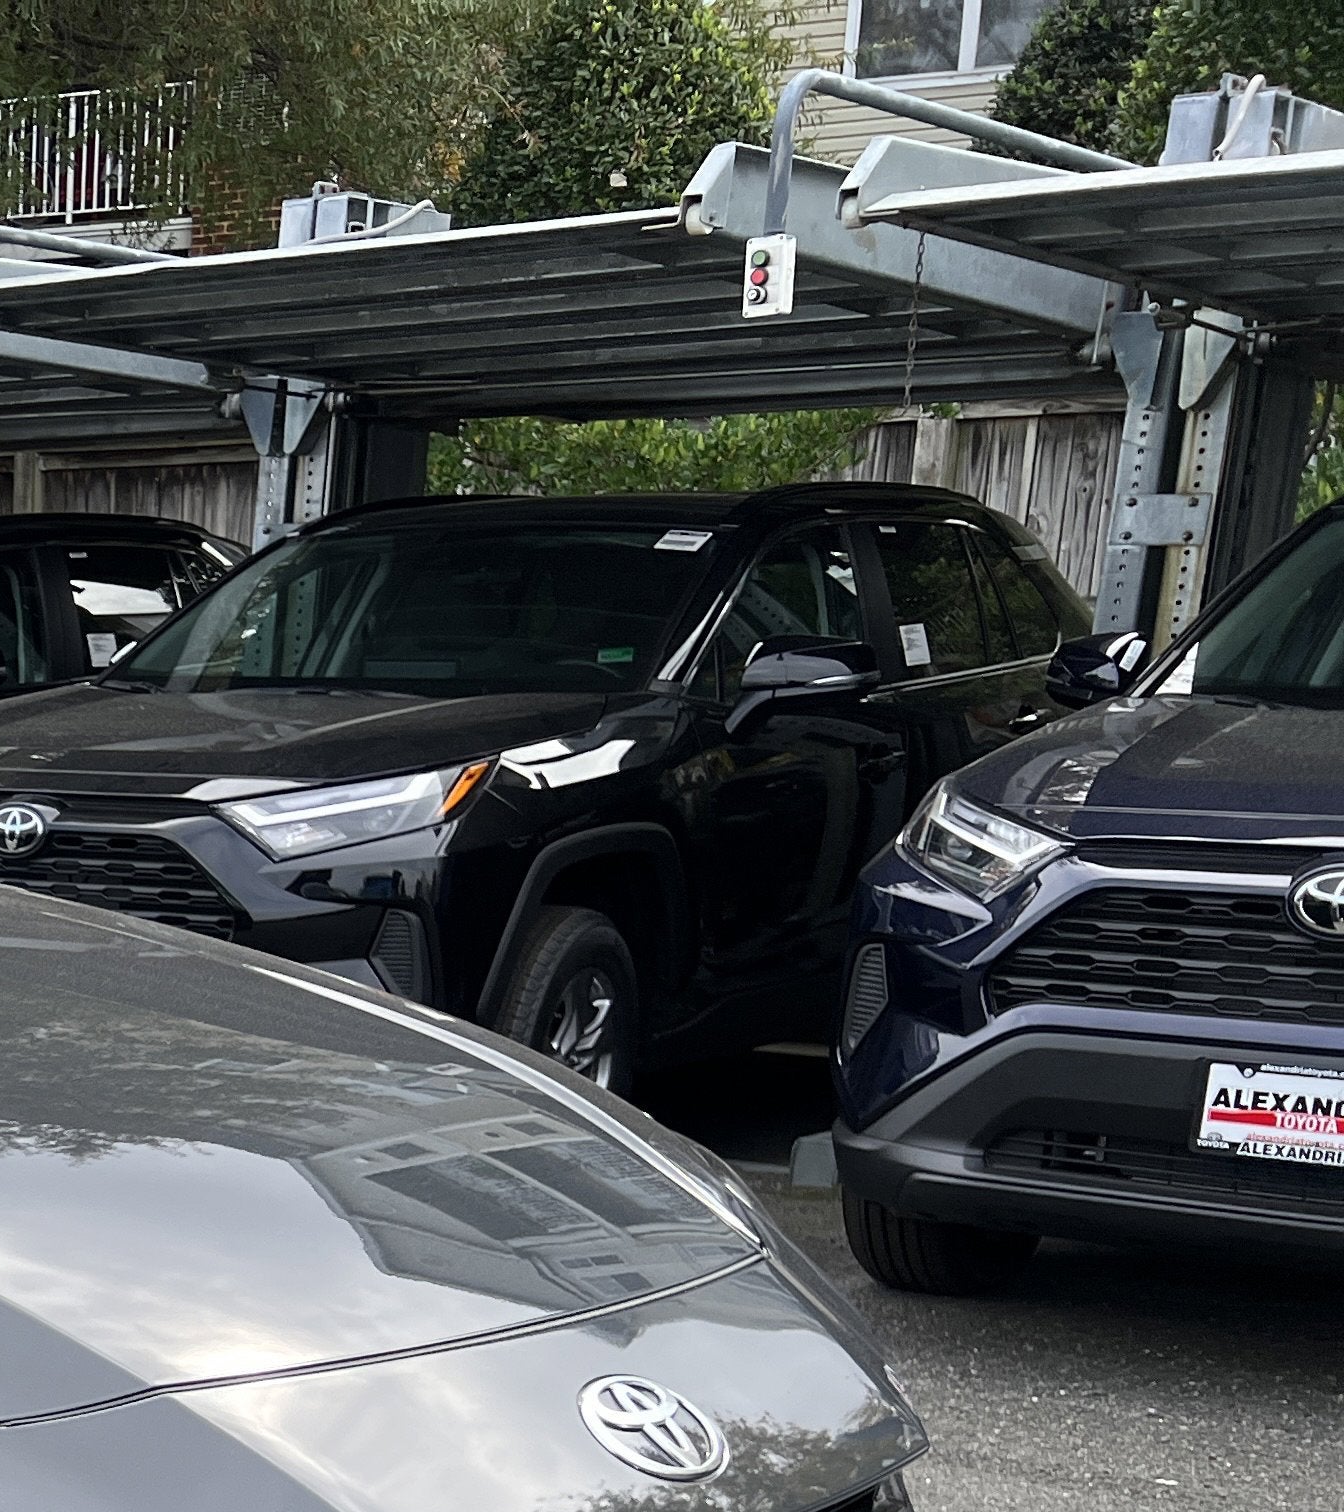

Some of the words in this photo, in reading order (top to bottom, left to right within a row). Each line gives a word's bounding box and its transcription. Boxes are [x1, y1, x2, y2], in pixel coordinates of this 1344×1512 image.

[1275, 1112, 1338, 1134] TOYOTA
[1197, 1138, 1230, 1150] TOYOTA
[1240, 1142, 1344, 1165] ALEXANDRI
